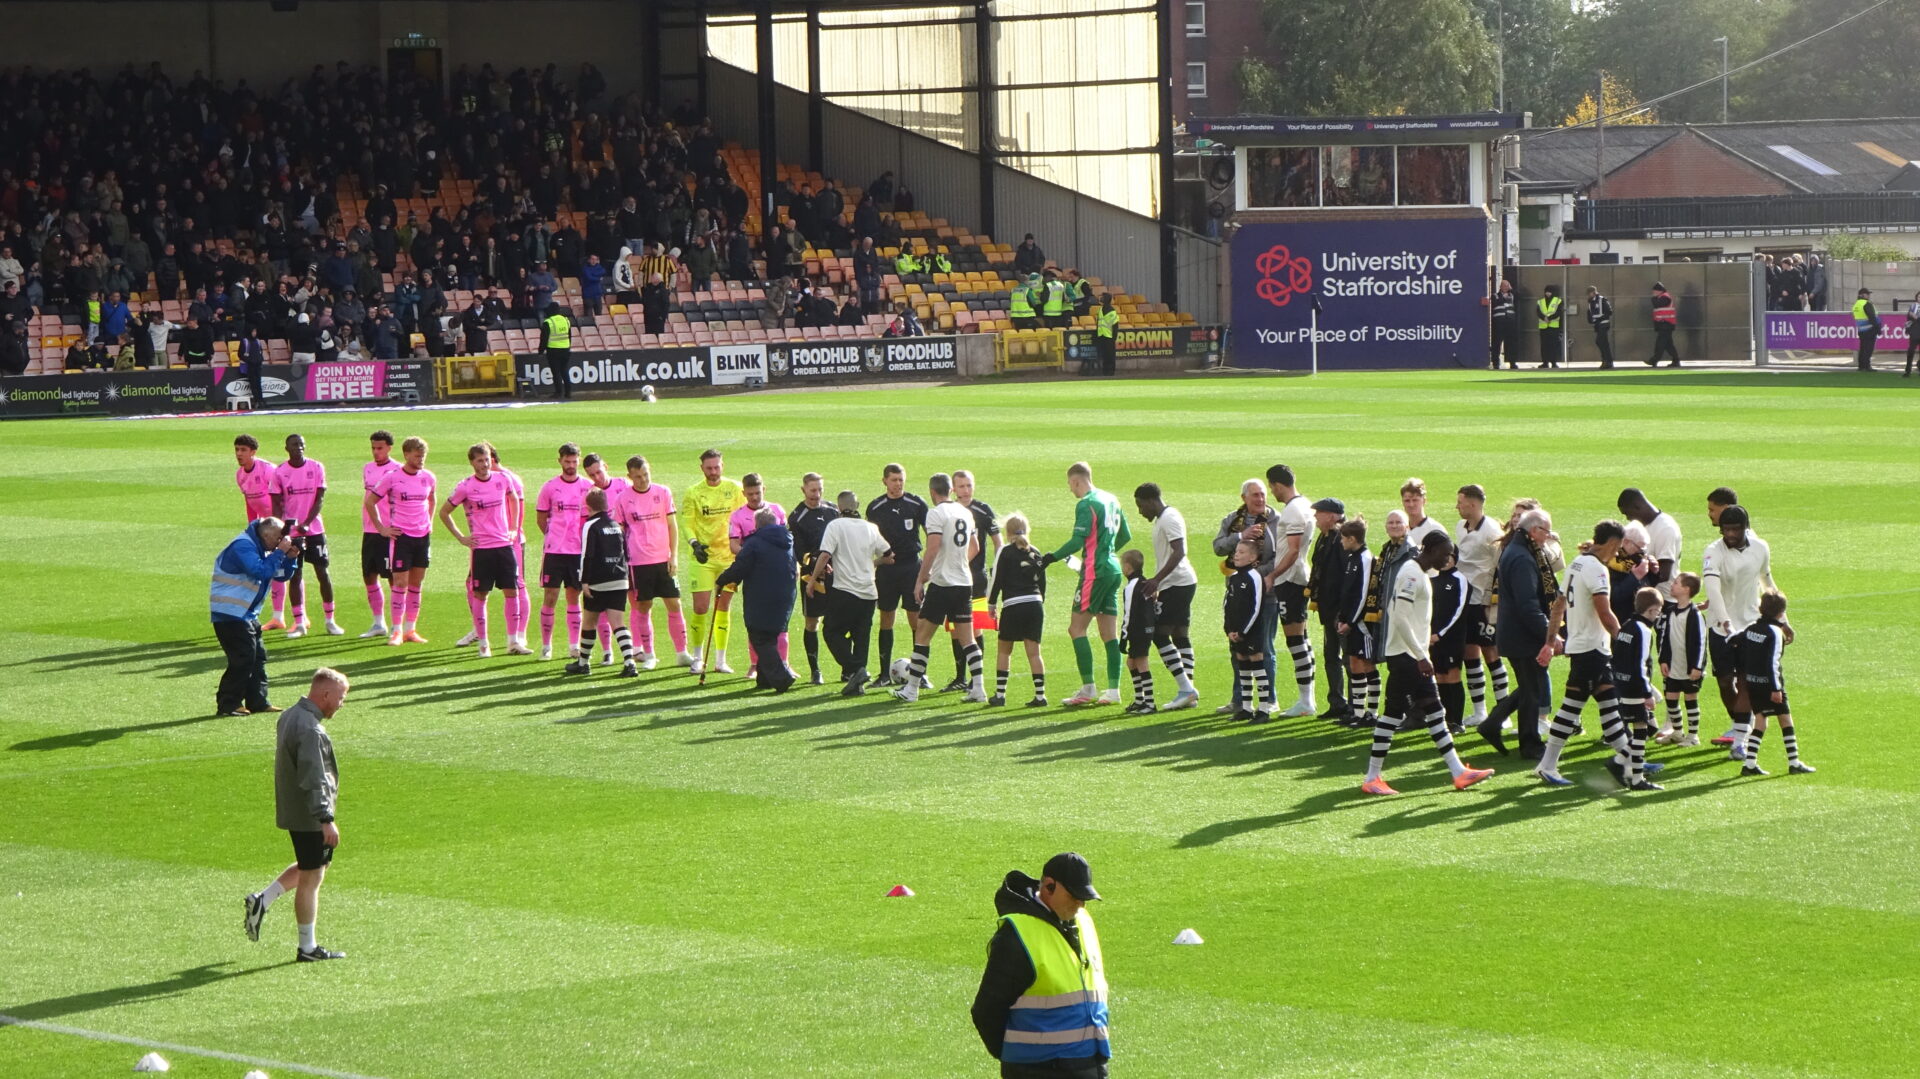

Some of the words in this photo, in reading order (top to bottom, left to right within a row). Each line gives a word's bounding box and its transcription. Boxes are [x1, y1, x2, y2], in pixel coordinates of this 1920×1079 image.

[1322, 251, 1430, 274] University
[1434, 250, 1457, 270] of
[1322, 276, 1463, 297] Staffordshire
[1115, 330, 1173, 350] BROWN
[1256, 328, 1296, 344] Your
[1299, 327, 1346, 343] Place
[1349, 326, 1368, 342] of
[1375, 324, 1463, 344] Possibility
[716, 353, 761, 370] BLINK
[792, 346, 860, 366] FOODHUB
[888, 342, 953, 362] FOODHUB
[315, 366, 343, 377] JOIN
[346, 365, 375, 376] NOW
[524, 356, 706, 386] Heoblink.co.uk
[793, 367, 820, 376] ORDER.
[821, 366, 836, 374] EAT.
[837, 365, 862, 374] ENJOY.
[889, 364, 915, 372] ORDER.
[931, 360, 956, 369] ENJOY.
[10, 387, 61, 401] diamond
[61, 391, 72, 399] led
[73, 390, 99, 401] lighting
[122, 383, 171, 397] diamond
[171, 387, 181, 395] led
[182, 386, 207, 397] lighting
[233, 381, 286, 392] Dimsions
[316, 381, 375, 400] FREE
[954, 518, 968, 547] 8
[1567, 574, 1574, 608] 6
[1279, 601, 1287, 615] 5
[1478, 621, 1496, 636] 26
